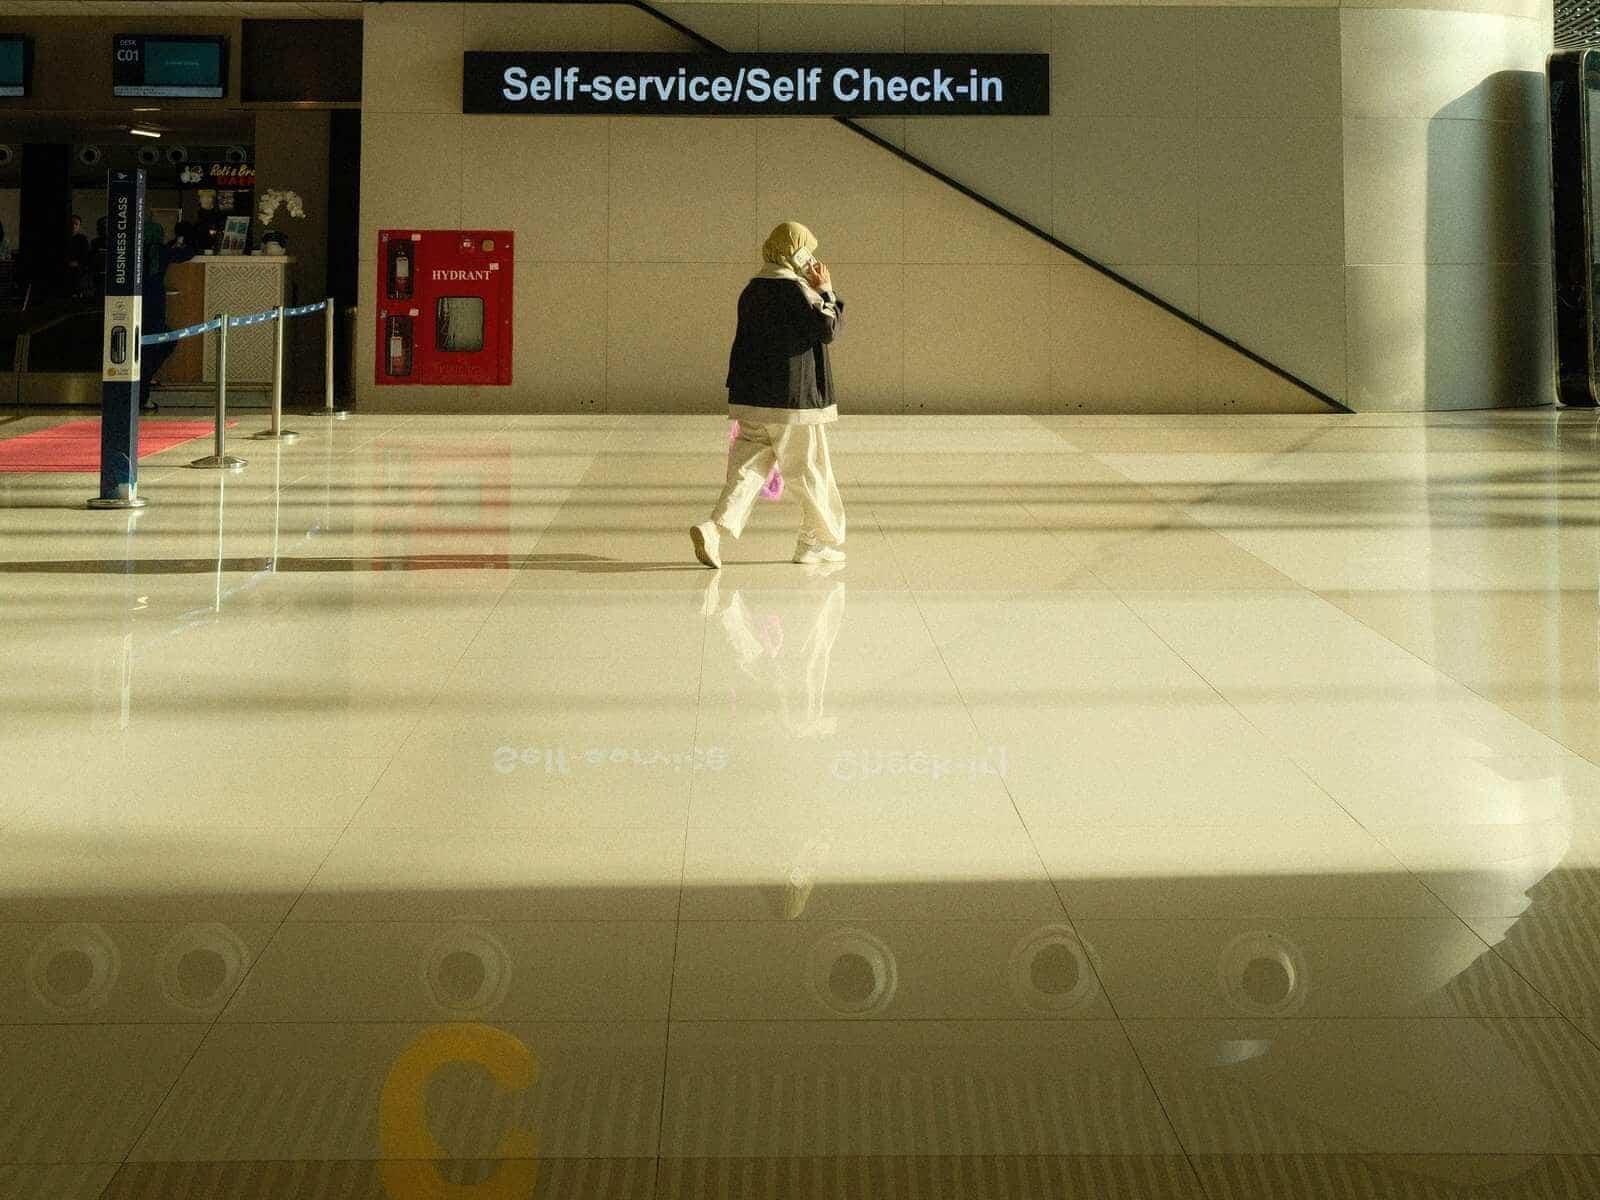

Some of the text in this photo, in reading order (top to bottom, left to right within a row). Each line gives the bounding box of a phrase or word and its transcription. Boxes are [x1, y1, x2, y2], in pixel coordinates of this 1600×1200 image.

[117, 49, 139, 62] C01
[502, 66, 1003, 103] Self-service/Self Check-in
[115, 196, 128, 285] BUSINESS CLASS
[432, 269, 492, 281] HYDRANT
